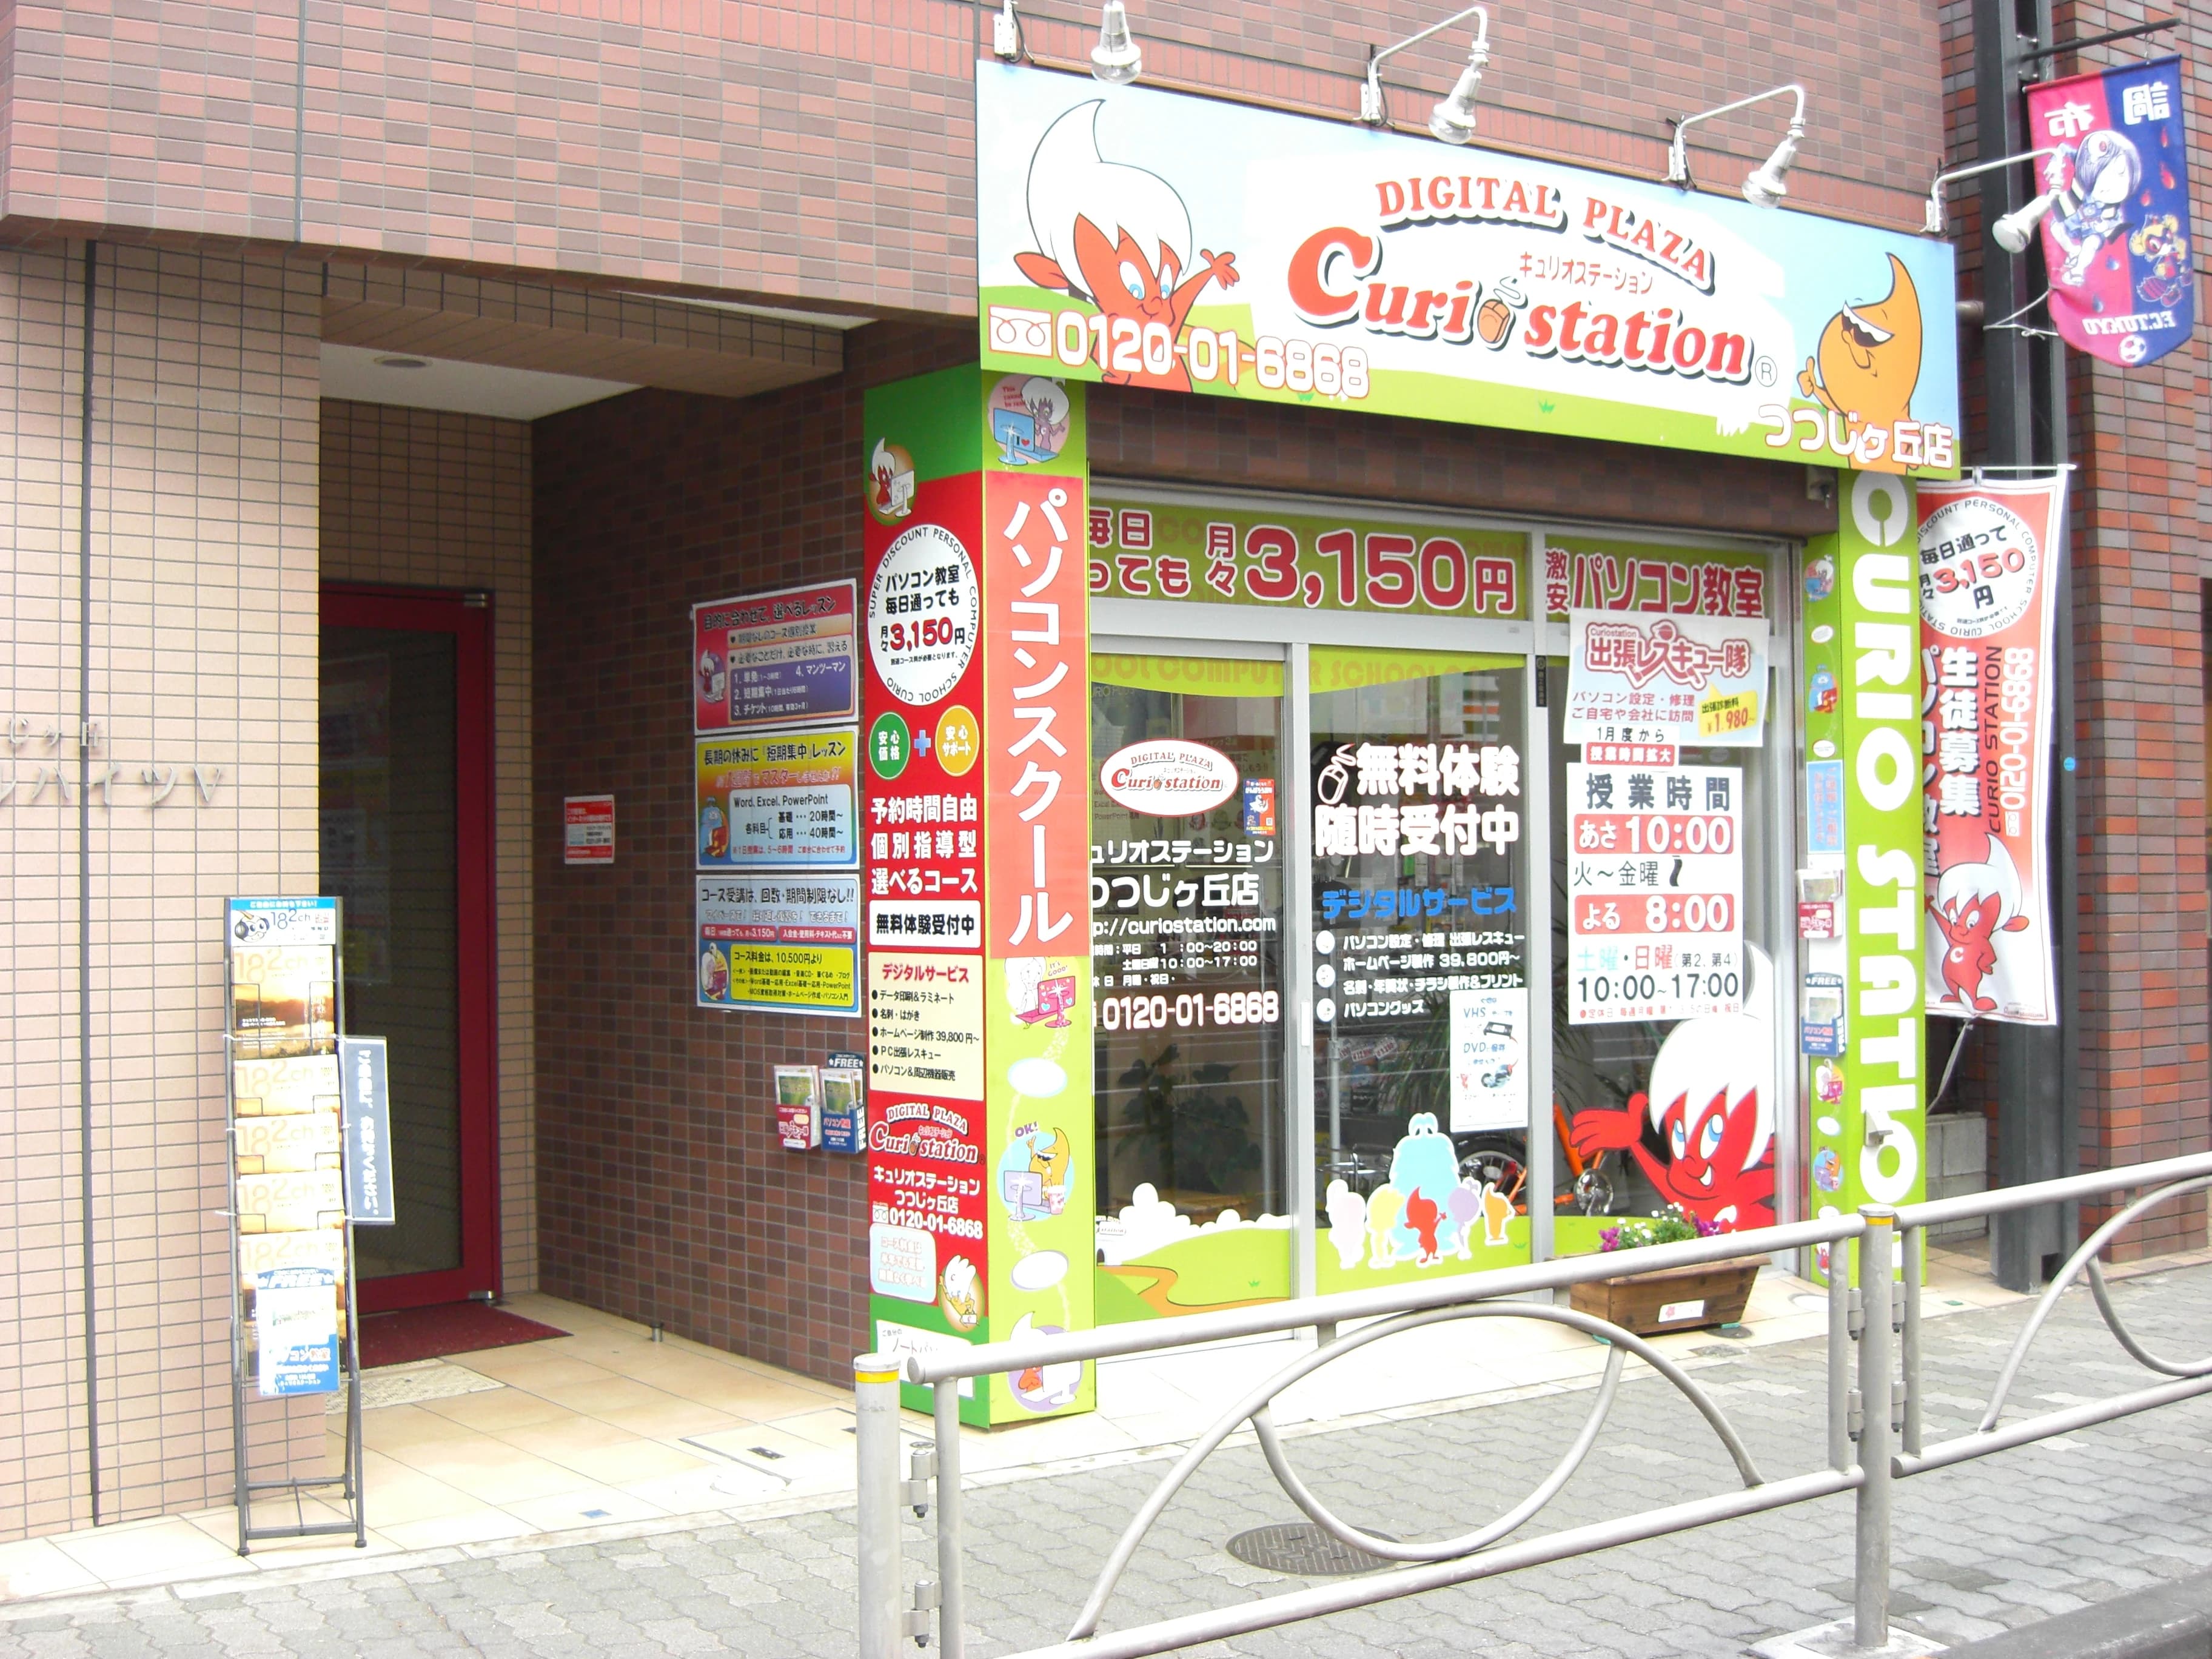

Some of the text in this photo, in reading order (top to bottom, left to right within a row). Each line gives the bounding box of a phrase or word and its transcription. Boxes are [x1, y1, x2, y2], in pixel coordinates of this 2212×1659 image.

[1375, 176, 1705, 281] DIGITAL PLAZA
[1519, 251, 1653, 294] キュリオステーション
[1057, 310, 1370, 399] 0120-01-6868
[1965, 499, 2020, 530] PERSONAL
[2022, 531, 2036, 594] COMPUTER
[886, 565, 960, 592] パソコン教室
[1573, 554, 1763, 619] パソコン教室
[869, 527, 977, 703] SUPER DISCOUNT PERSONAL COMPUTER SCHOOL CURIO
[886, 588, 960, 615] 毎日通っても
[1590, 628, 1637, 638] Curiostation
[1590, 638, 1746, 680] 出張レスキュー隊
[1571, 707, 1695, 723] ご自宅や会社に訪問
[1572, 691, 1695, 707] パソコン設定・修理
[1003, 489, 1073, 946] パソコンスクール
[1939, 646, 1982, 817] 生徒募集
[2000, 648, 2034, 810] 0120-01-6868
[942, 742, 971, 757] サポート
[1985, 646, 2002, 834] CURIO STATION
[1131, 752, 1212, 768] DIGITAL PLAZA
[1356, 742, 1520, 796] 無料体験
[1586, 772, 1730, 811] 授業時間
[871, 793, 977, 825] 予約時間自由
[746, 822, 766, 835] 各科目
[1315, 803, 1520, 857] 随時受付中
[1578, 815, 1731, 853] あさ 10:00
[871, 830, 977, 860] 個別指導型
[871, 868, 977, 895] 選べるコース
[1322, 886, 1517, 920] デジタルサービス
[1582, 894, 1729, 932] よる 8:00
[876, 913, 974, 936] 無料体験受付中
[882, 963, 969, 983] デジタルサービス
[1811, 976, 1837, 985] FREE
[1102, 990, 1279, 1030] 0120-01-6868
[1343, 999, 1424, 1018] パソコングッズ
[1463, 1007, 1486, 1018] VHS
[834, 1058, 859, 1067] FREE
[856, 1105, 866, 1150] FREE
[887, 1104, 967, 1133] DIGITAL PLAZA
[1015, 1121, 1038, 1137] OK!
[874, 1165, 980, 1196] キュリオステーション
[890, 1207, 983, 1239] 0120-01-6868
